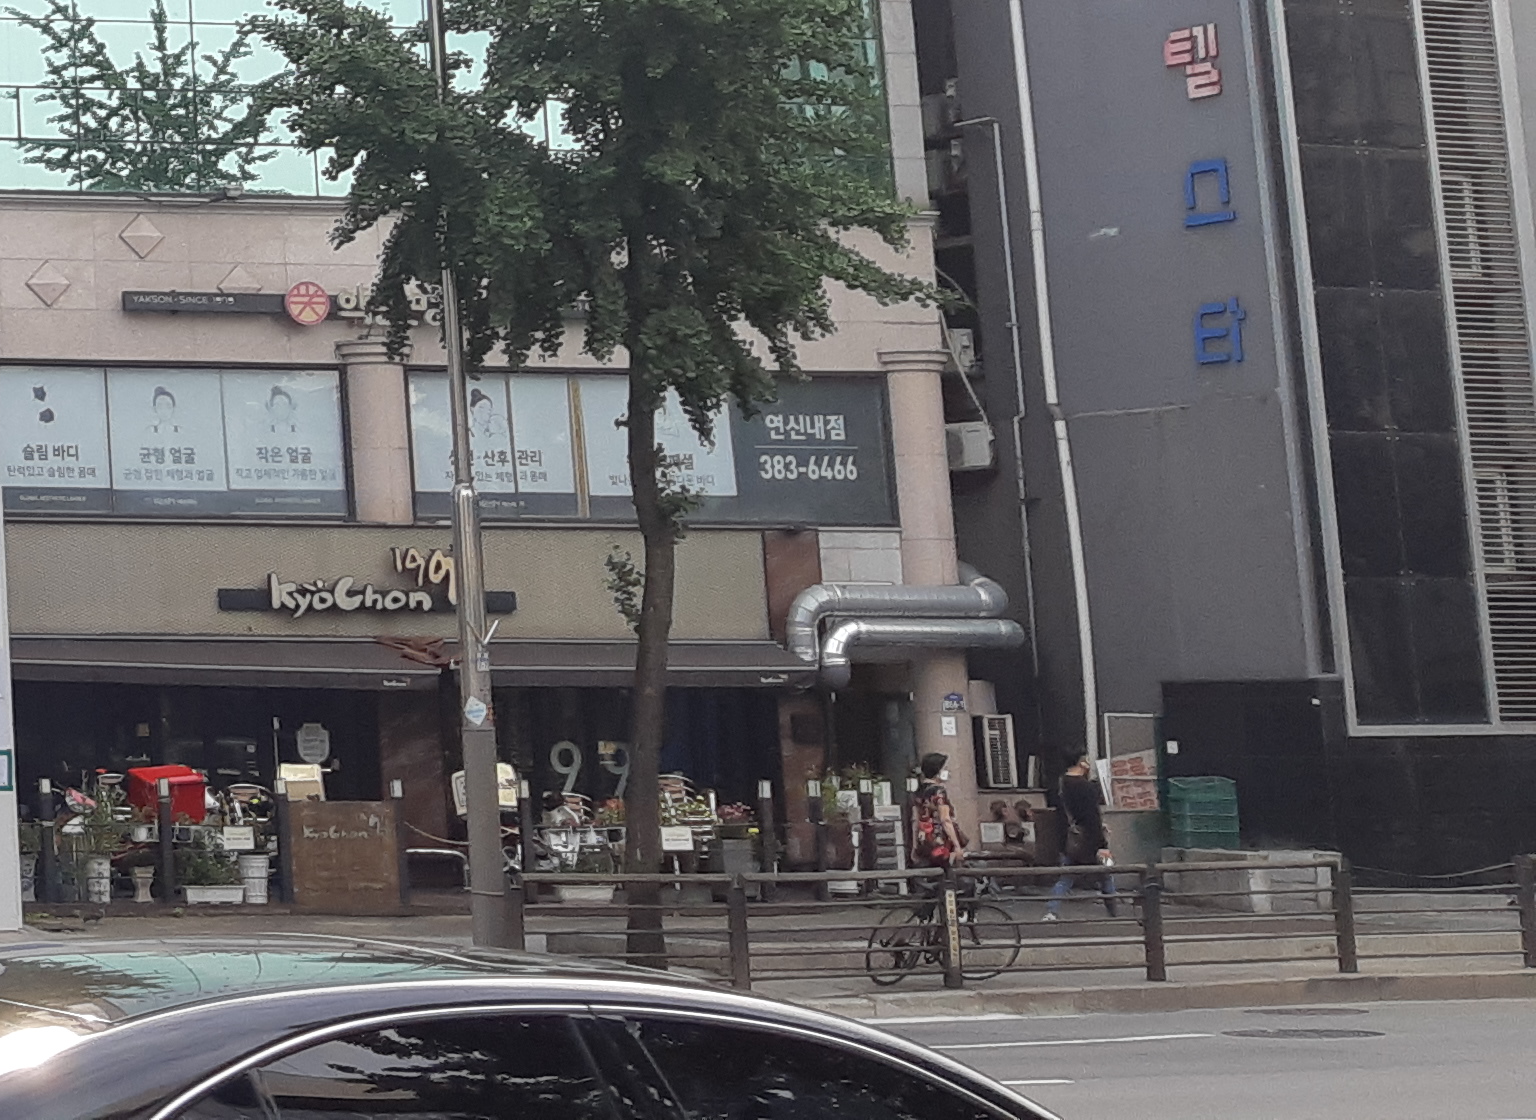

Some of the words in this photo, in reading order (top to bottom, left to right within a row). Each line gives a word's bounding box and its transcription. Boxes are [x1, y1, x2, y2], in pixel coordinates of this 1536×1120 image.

[764, 413, 846, 442] 연신내점
[22, 444, 48, 461] 슬림
[52, 444, 80, 462] 바디
[138, 446, 165, 464] 균형
[169, 447, 197, 464] 얼굴
[255, 446, 283, 463] 작은
[285, 446, 313, 464] 얼굴
[516, 449, 543, 467] 관리
[758, 453, 859, 482] 383-6466
[391, 547, 458, 605] 199
